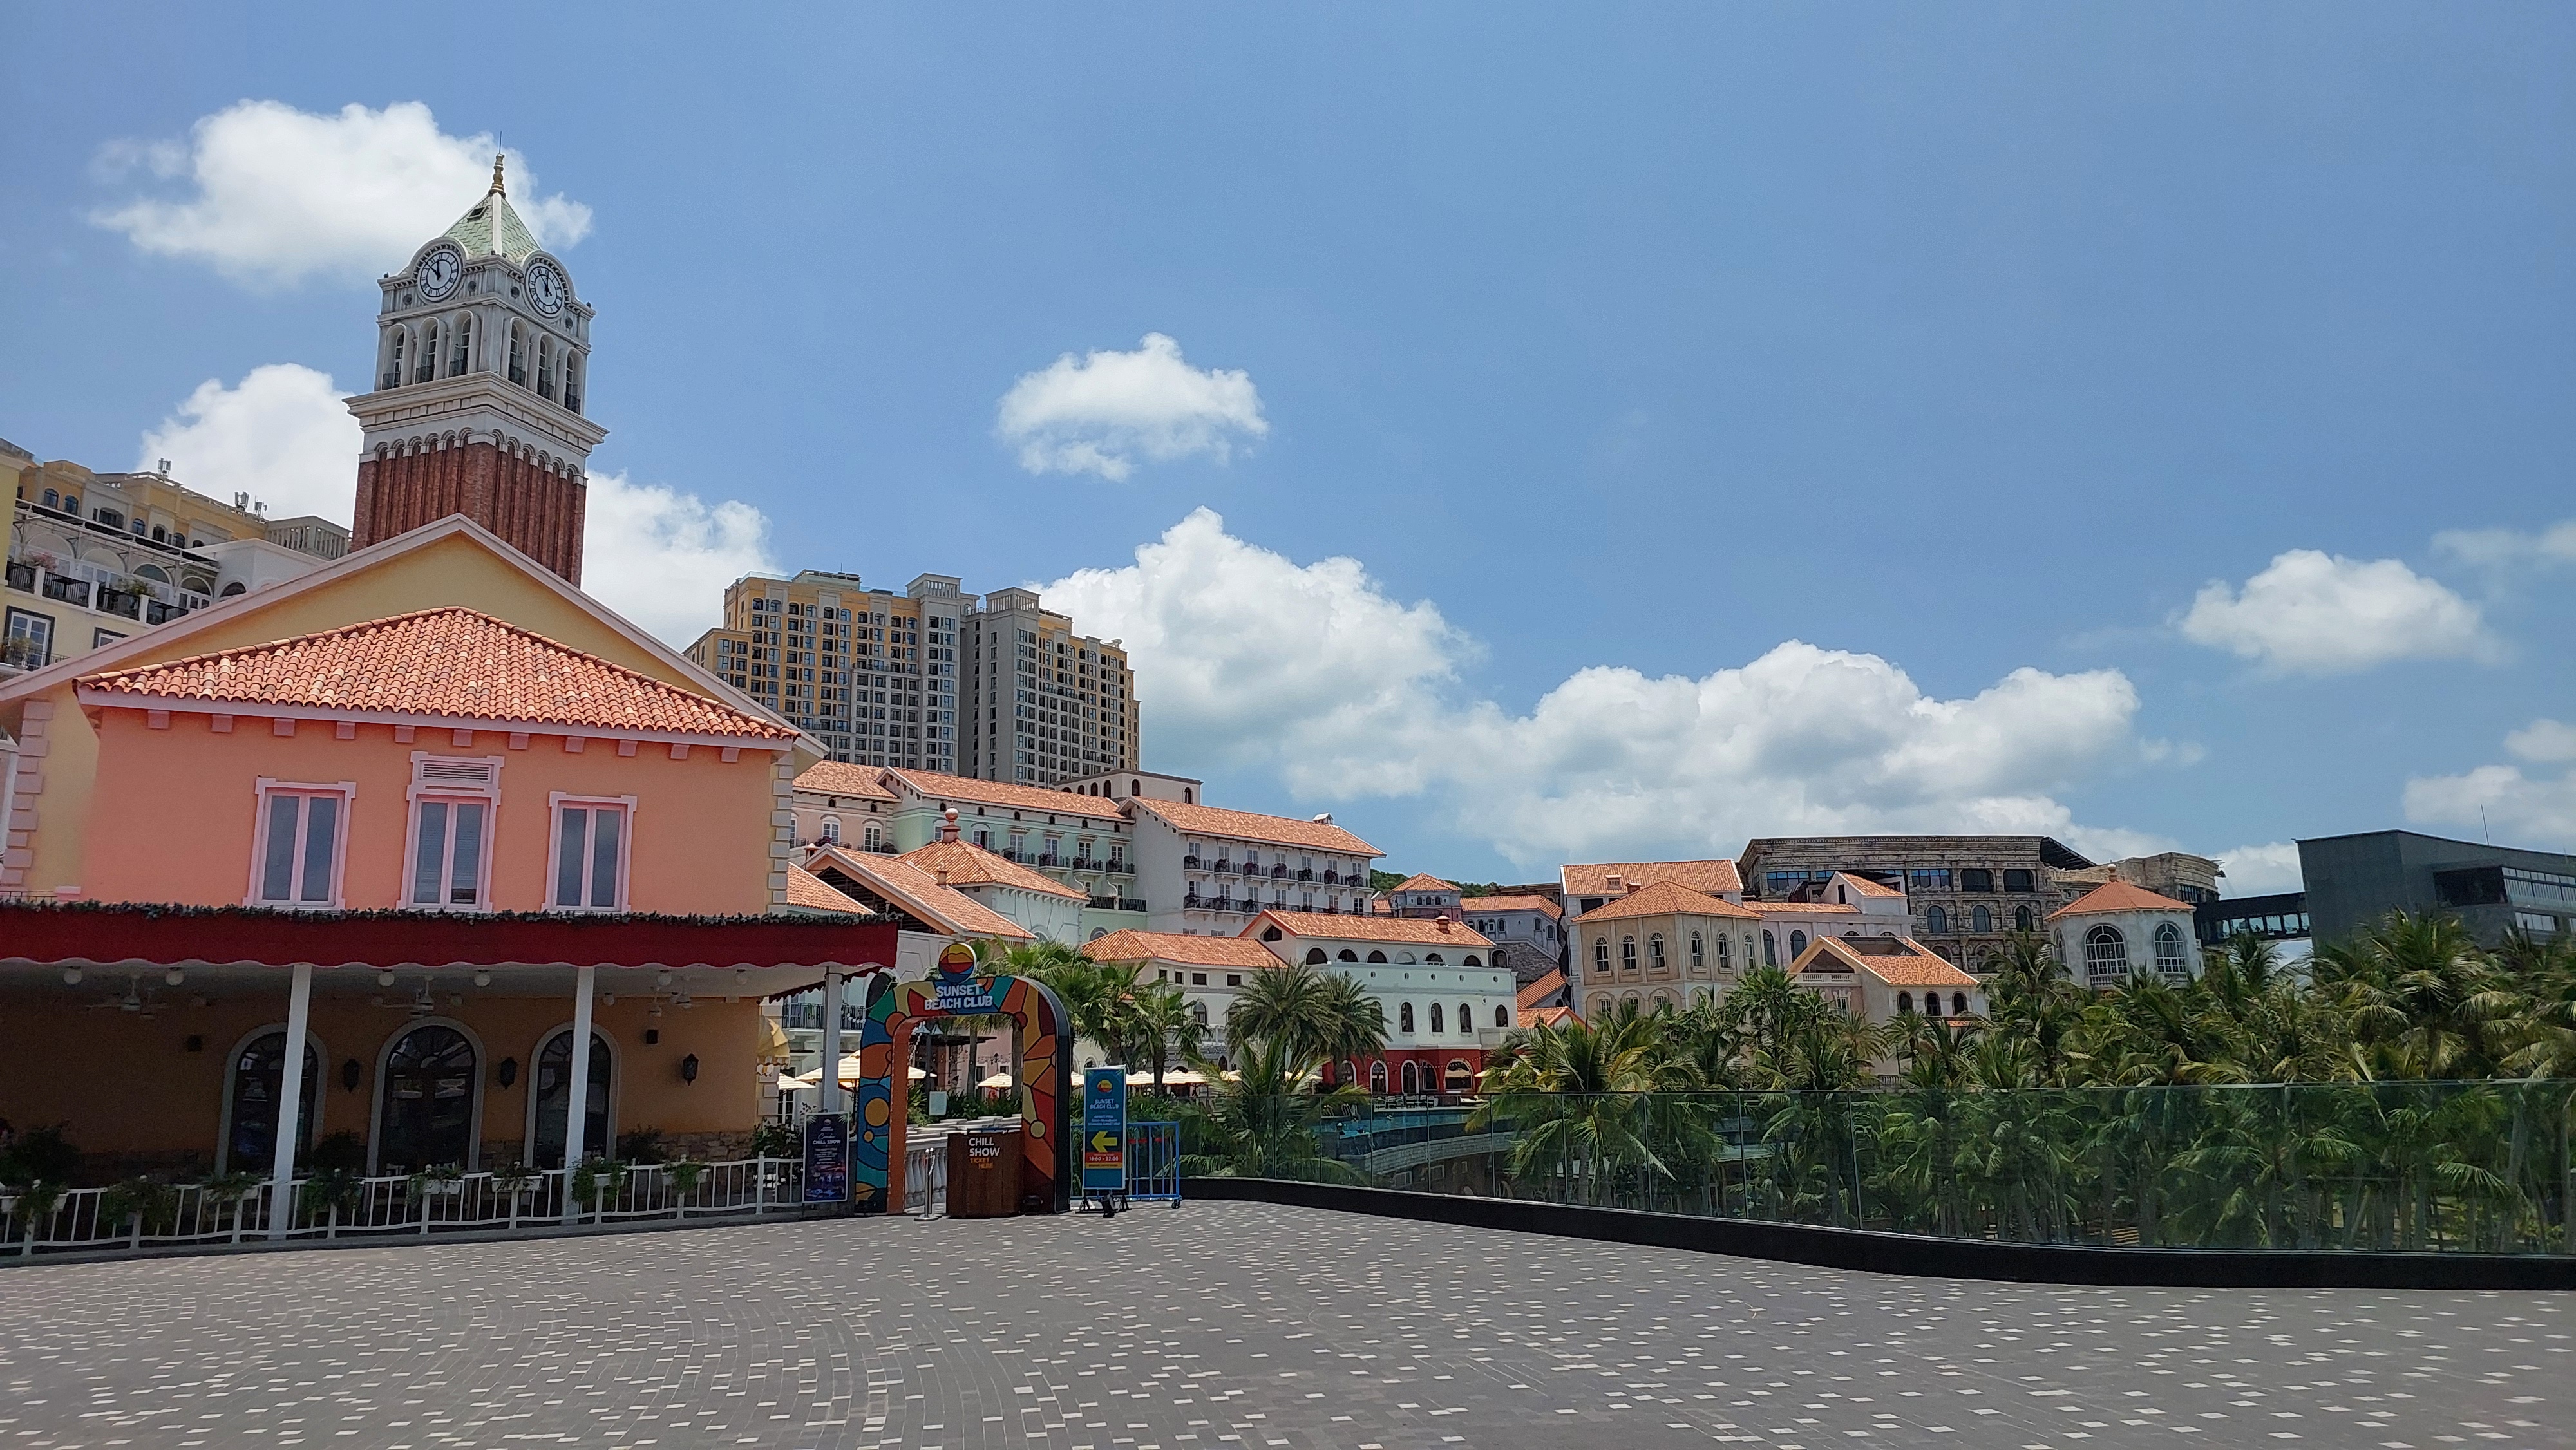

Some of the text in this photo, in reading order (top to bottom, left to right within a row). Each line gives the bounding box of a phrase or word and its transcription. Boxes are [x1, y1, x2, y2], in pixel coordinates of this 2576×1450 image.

[936, 984, 982, 997] SUNSET
[925, 995, 993, 1010] BEACH CLUB
[969, 1137, 994, 1146] CHILL
[969, 1147, 1000, 1156] SHOW
